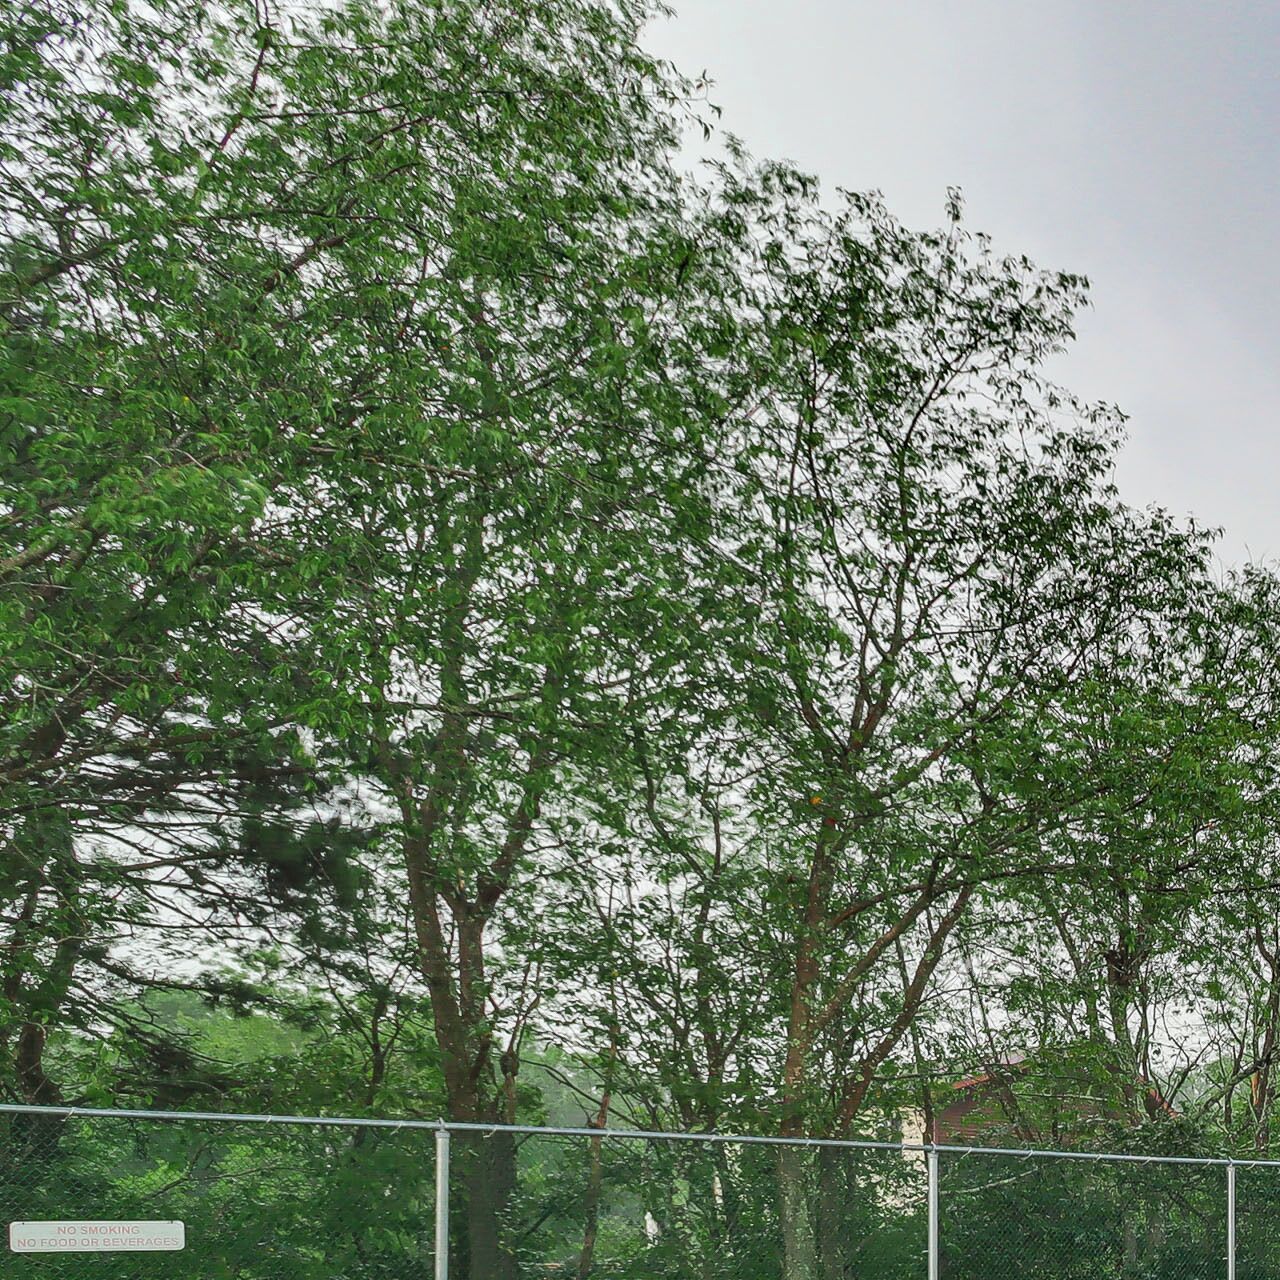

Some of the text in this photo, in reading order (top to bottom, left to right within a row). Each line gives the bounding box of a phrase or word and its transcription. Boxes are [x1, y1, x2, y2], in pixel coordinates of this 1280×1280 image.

[57, 1225, 140, 1235] NO SMOKING
[17, 1237, 179, 1248] NO FOOD OR BEVERAGES
